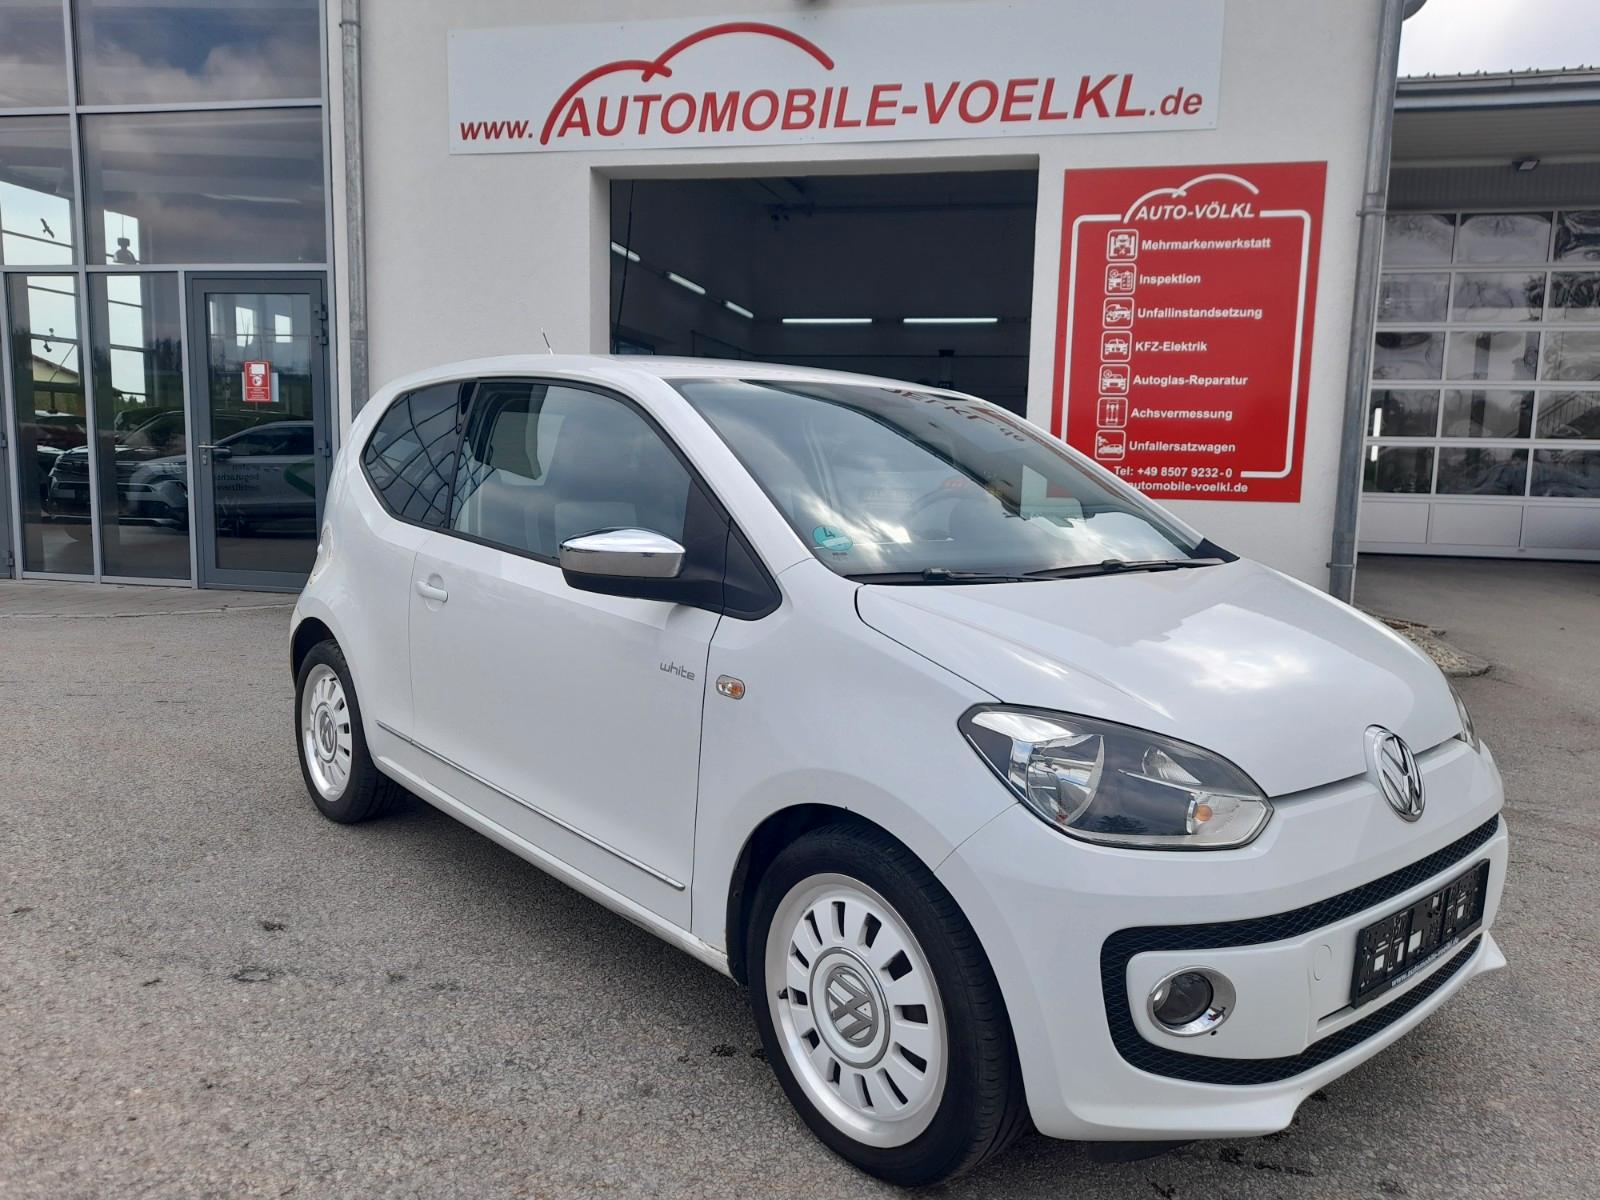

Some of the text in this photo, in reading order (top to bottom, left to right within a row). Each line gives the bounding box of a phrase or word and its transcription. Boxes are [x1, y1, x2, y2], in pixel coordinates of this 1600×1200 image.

[1135, 201, 1255, 221] AUTO-VÖLKL
[1141, 237, 1272, 250] Mehrmarkenwerkstatt
[1139, 273, 1201, 286] Inspektion
[1137, 307, 1263, 319] Unfallinstandsetzung
[1135, 340, 1208, 352] KFZ-Elektrik
[1132, 374, 1249, 386] Autoglas-Reparatur
[1130, 408, 1233, 421] Achsvermessung
[1129, 440, 1236, 453] Unfallersatzwagen
[1114, 465, 1134, 476] Tel:
[1137, 466, 1158, 477] +49
[1161, 466, 1188, 477] 8507
[659, 662, 695, 680] white
